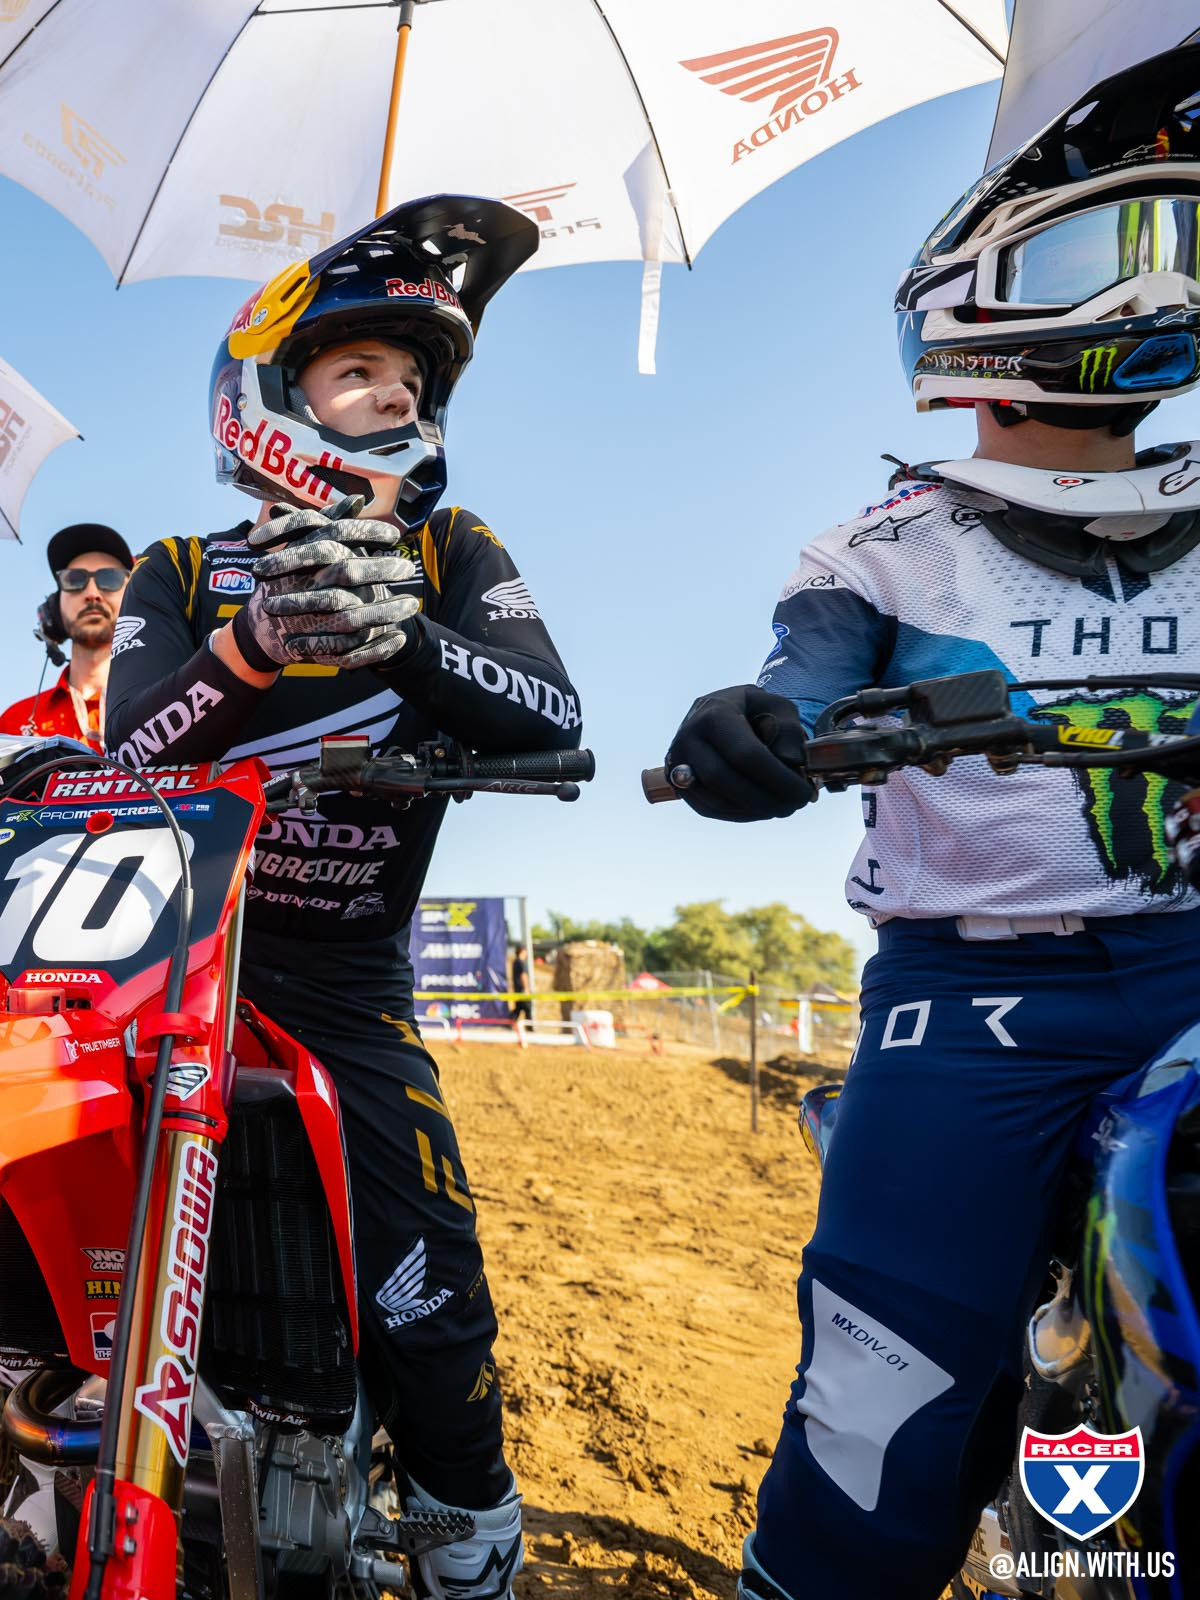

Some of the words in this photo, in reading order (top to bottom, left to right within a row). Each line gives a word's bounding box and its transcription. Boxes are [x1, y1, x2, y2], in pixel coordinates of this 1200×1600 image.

[386, 278, 434, 298] Red
[213, 394, 269, 463] Red
[260, 428, 344, 503] Bull
[215, 573, 251, 589] 100%
[487, 608, 539, 621] HON
[441, 638, 583, 730] HONDA
[52, 775, 196, 798] RENTHAL
[254, 816, 401, 851] ONDA
[24, 972, 103, 984] HONDA
[80, 1037, 121, 1053] TRUETIMBER
[166, 1142, 219, 1364] SHOWA
[384, 1287, 454, 1329] HONDA
[831, 1312, 910, 1371] MXDIV_01
[23, 1358, 45, 1368] Air
[249, 1400, 281, 1422] Twin
[282, 1414, 307, 1426] Air
